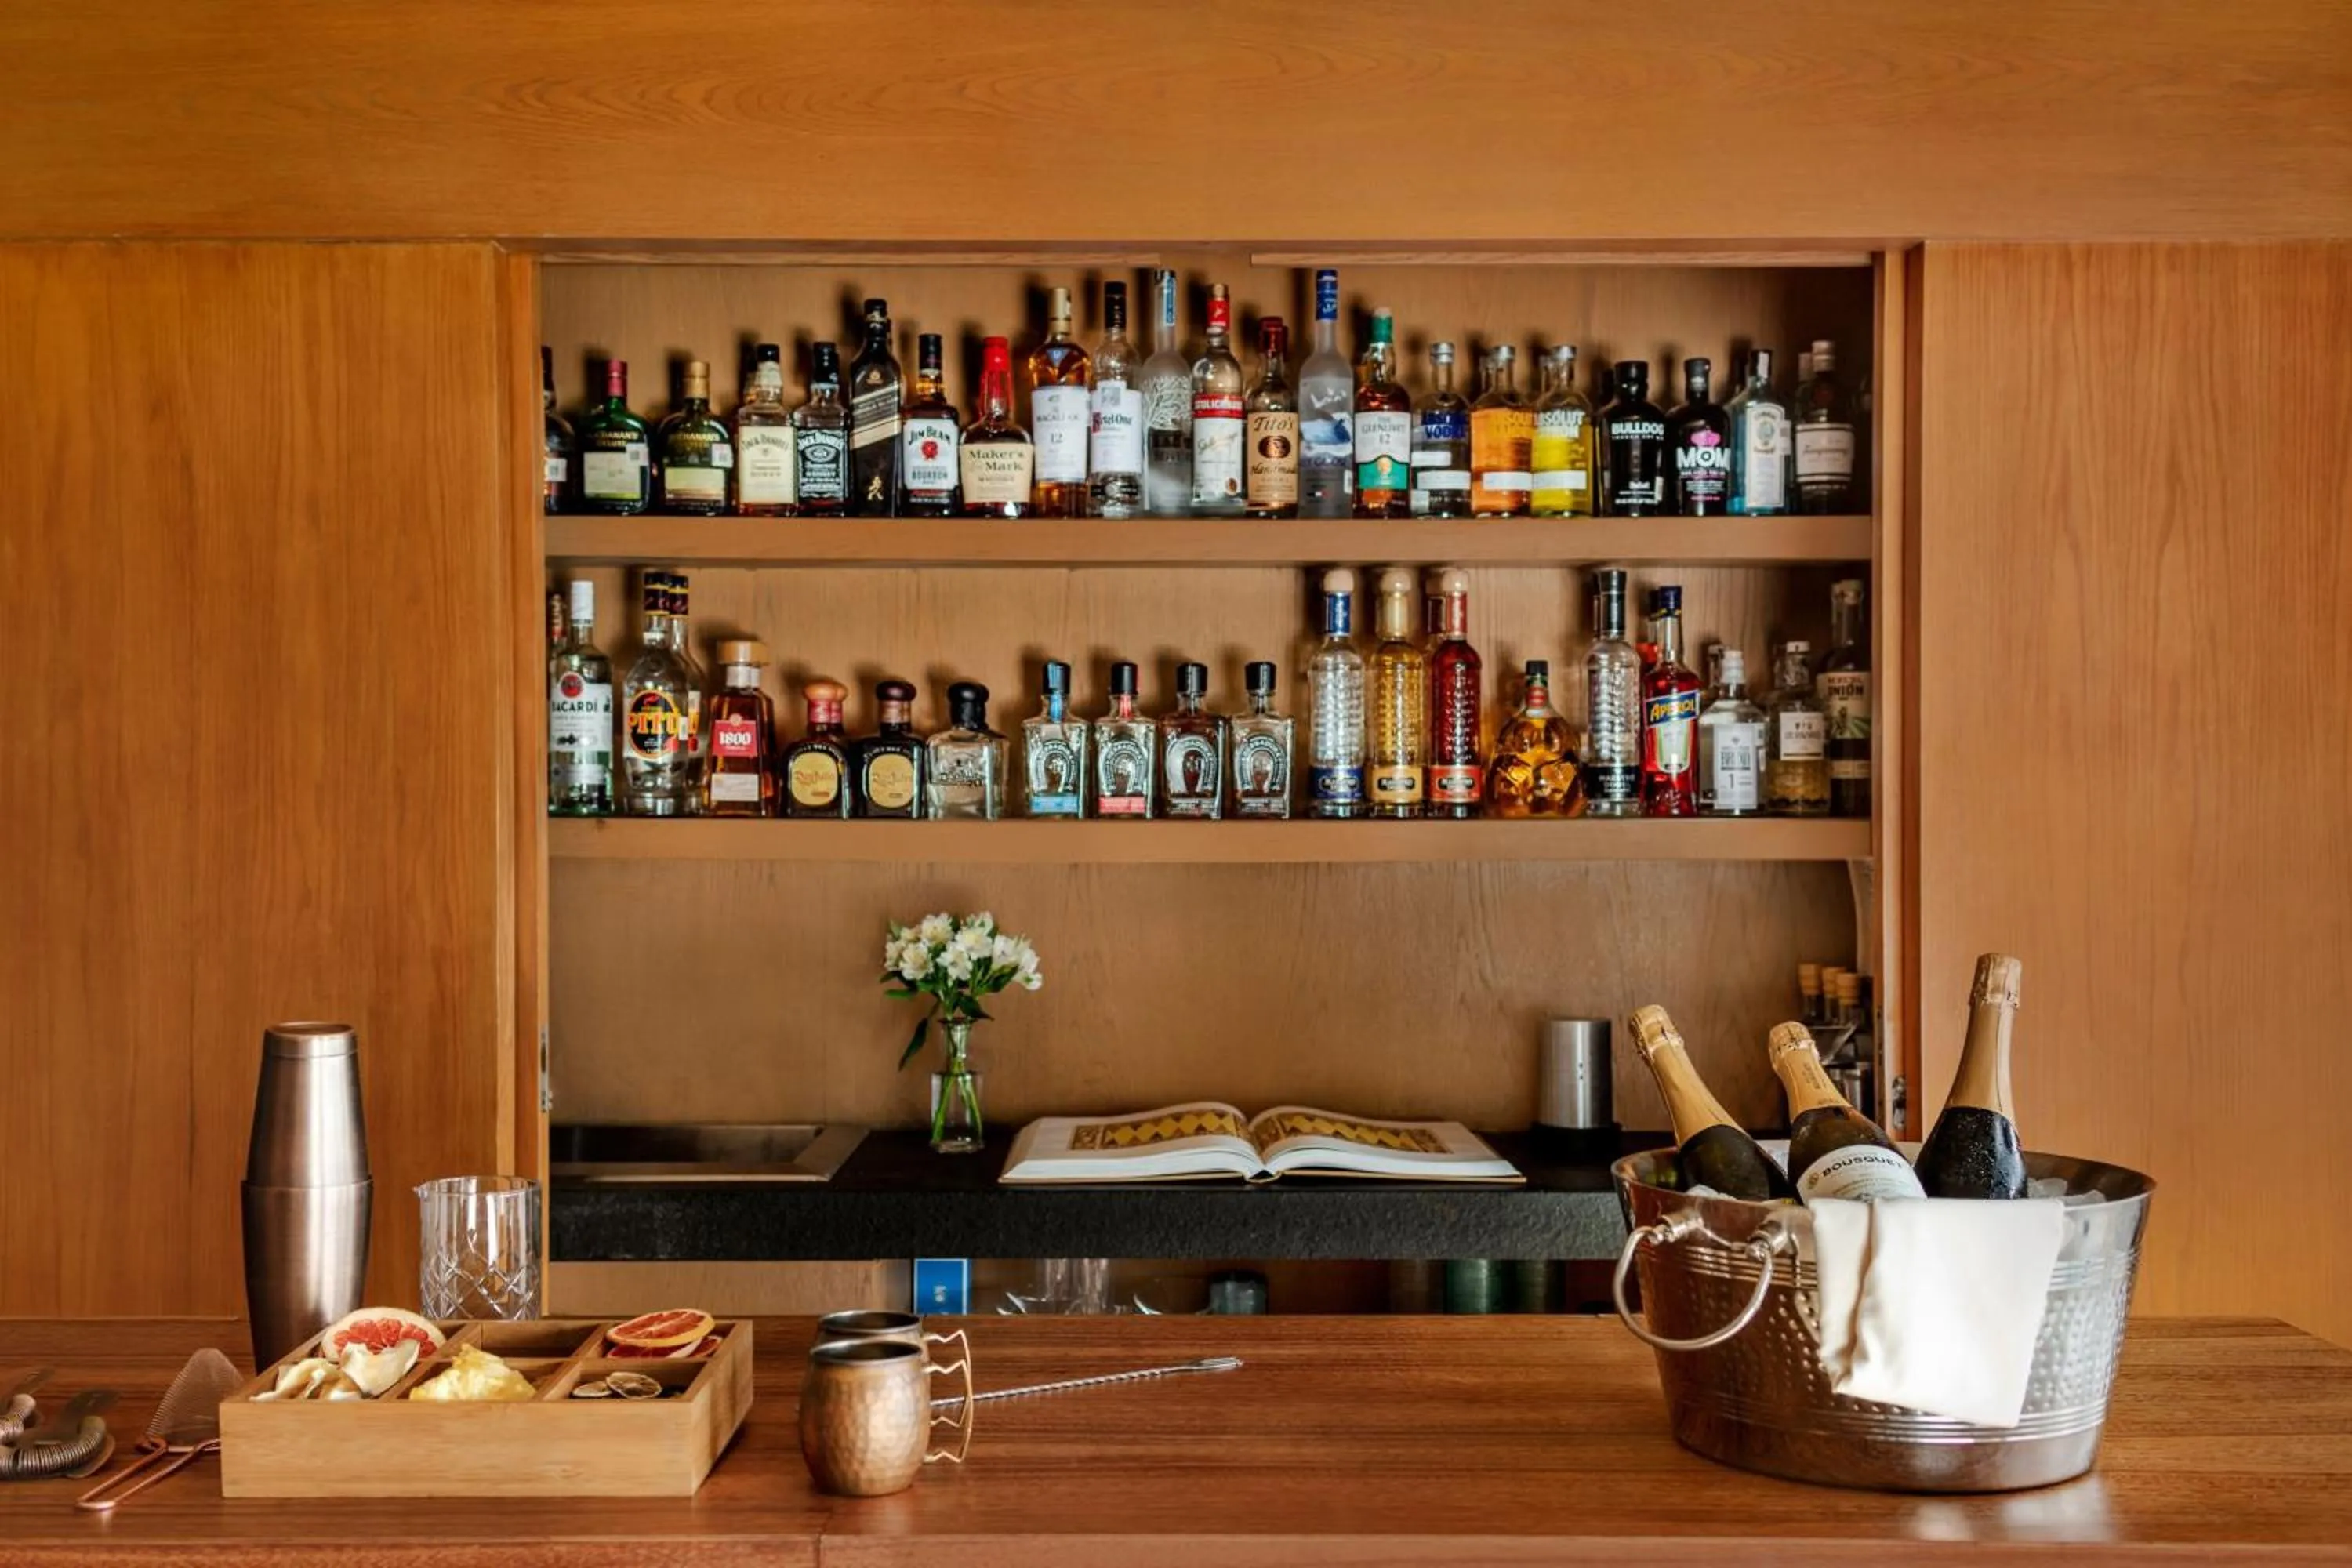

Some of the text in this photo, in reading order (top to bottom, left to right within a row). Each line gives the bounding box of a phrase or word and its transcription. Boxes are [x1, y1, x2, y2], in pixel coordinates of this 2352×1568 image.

[1254, 416, 1294, 432] Tito's
[909, 426, 951, 446] JIM BEAM
[1051, 432, 1063, 444] 12
[1378, 434, 1391, 445] 12
[968, 449, 1025, 459] Maker's
[1676, 447, 1731, 471] MOM
[985, 460, 1024, 472] Mark
[719, 731, 751, 746] 1800
[1821, 1155, 1903, 1177] BOUSQUET
